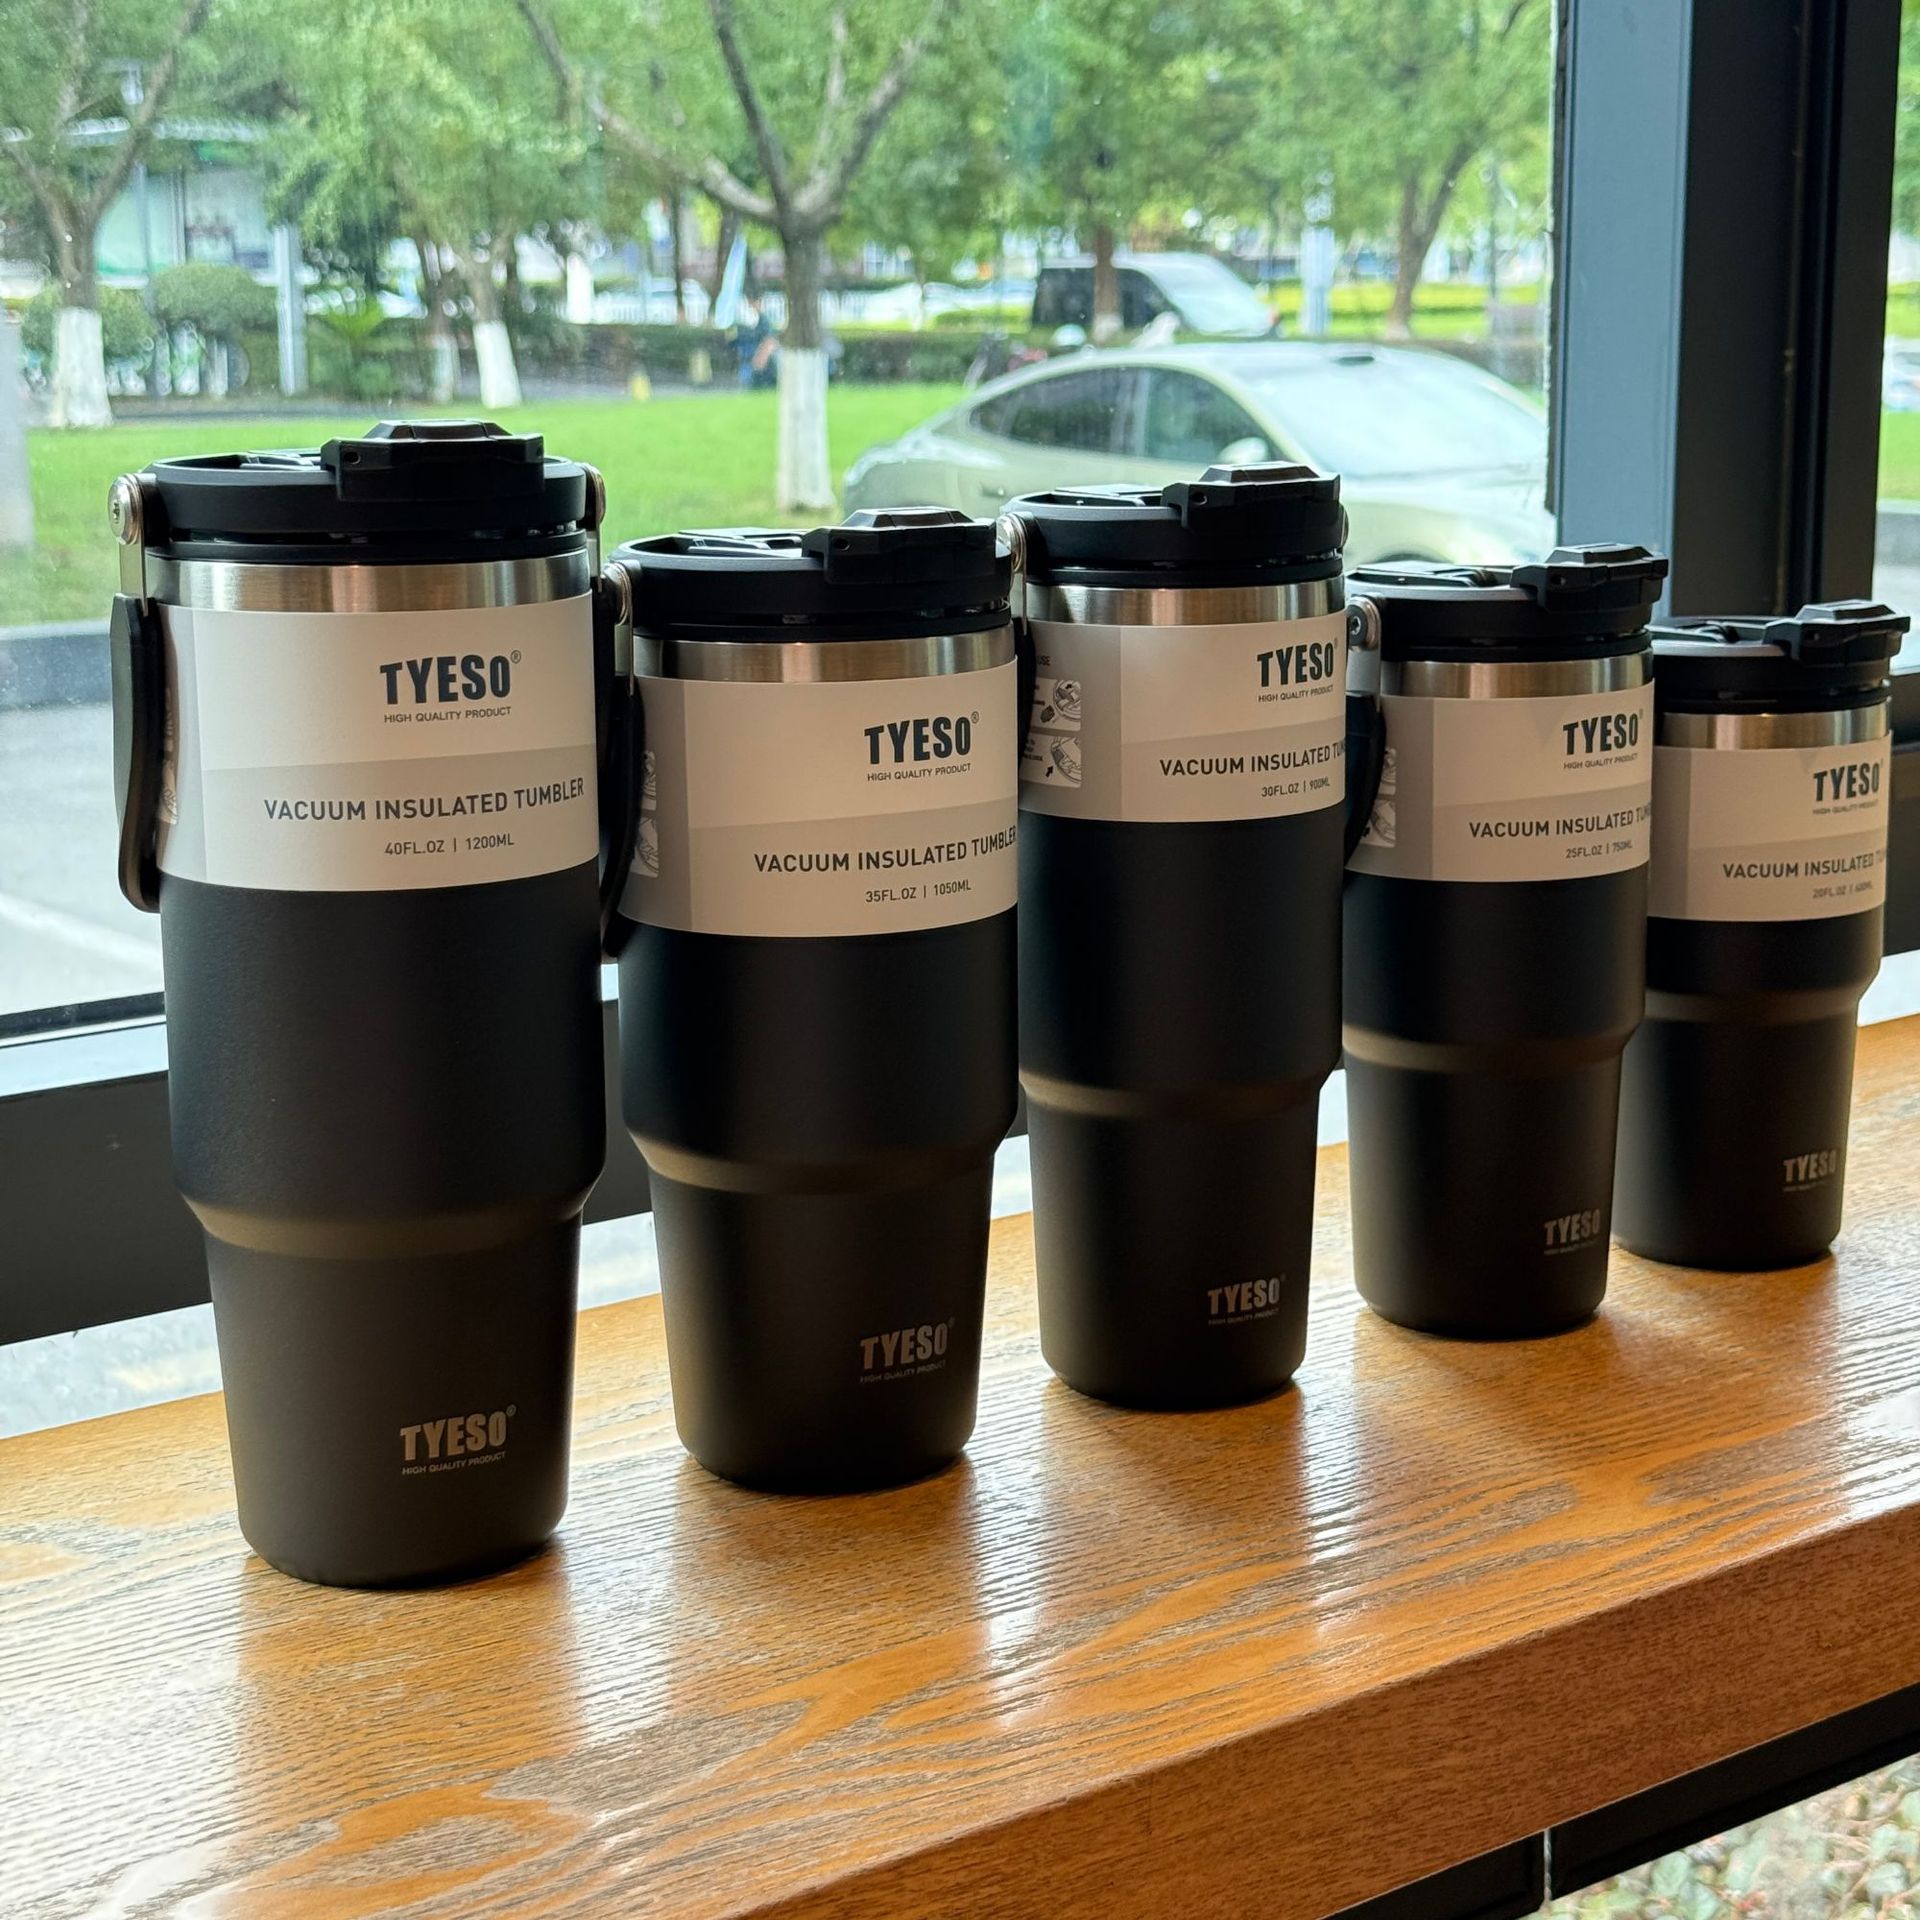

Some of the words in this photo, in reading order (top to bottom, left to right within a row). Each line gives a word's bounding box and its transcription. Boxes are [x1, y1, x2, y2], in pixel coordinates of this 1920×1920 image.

[380, 655, 512, 705] TYESO
[1257, 642, 1334, 687] TYESO
[1258, 694, 1278, 703] HIGH
[1280, 690, 1309, 701] QUALITY
[384, 713, 412, 724] HIGH
[416, 710, 462, 723] QUALITY
[465, 706, 512, 719] PRODUCT
[864, 716, 972, 765] TYESO
[1563, 713, 1639, 755] TYESO
[867, 771, 892, 782] HIGH
[894, 768, 933, 781] QUALITY
[935, 763, 972, 777] PRODUCT
[1160, 757, 1244, 777] VACUUM
[1251, 745, 1330, 772] INSULATED
[1585, 758, 1613, 769] QUALITY
[264, 799, 366, 821] VACUUM
[375, 792, 508, 820] INSULATED
[513, 777, 585, 810] TUMBLER
[1261, 783, 1299, 798] 30FL.OZ
[1813, 762, 1880, 802] TYESO
[1469, 820, 1549, 838] VACUUM
[1555, 810, 1634, 835] INSULATED
[384, 839, 446, 856] 40FL.OZ
[466, 833, 515, 851] 1200ML
[754, 853, 849, 873] VACUUM
[858, 842, 967, 871] INSULATED
[971, 825, 1017, 857] TUMBLER
[1723, 863, 1799, 878] VACUUM
[1804, 852, 1874, 876] INSULATED
[865, 887, 917, 904] 35FL.OZ
[934, 879, 972, 897] 1050ML
[1543, 1208, 1600, 1245] TYESO
[1207, 1278, 1280, 1314] TYESO
[860, 1323, 948, 1370] TYESO
[400, 1411, 507, 1461] TYESO
[402, 1466, 427, 1475] HIGH
[429, 1459, 467, 1472] QUALITY
[468, 1451, 506, 1467] PRODUCT
